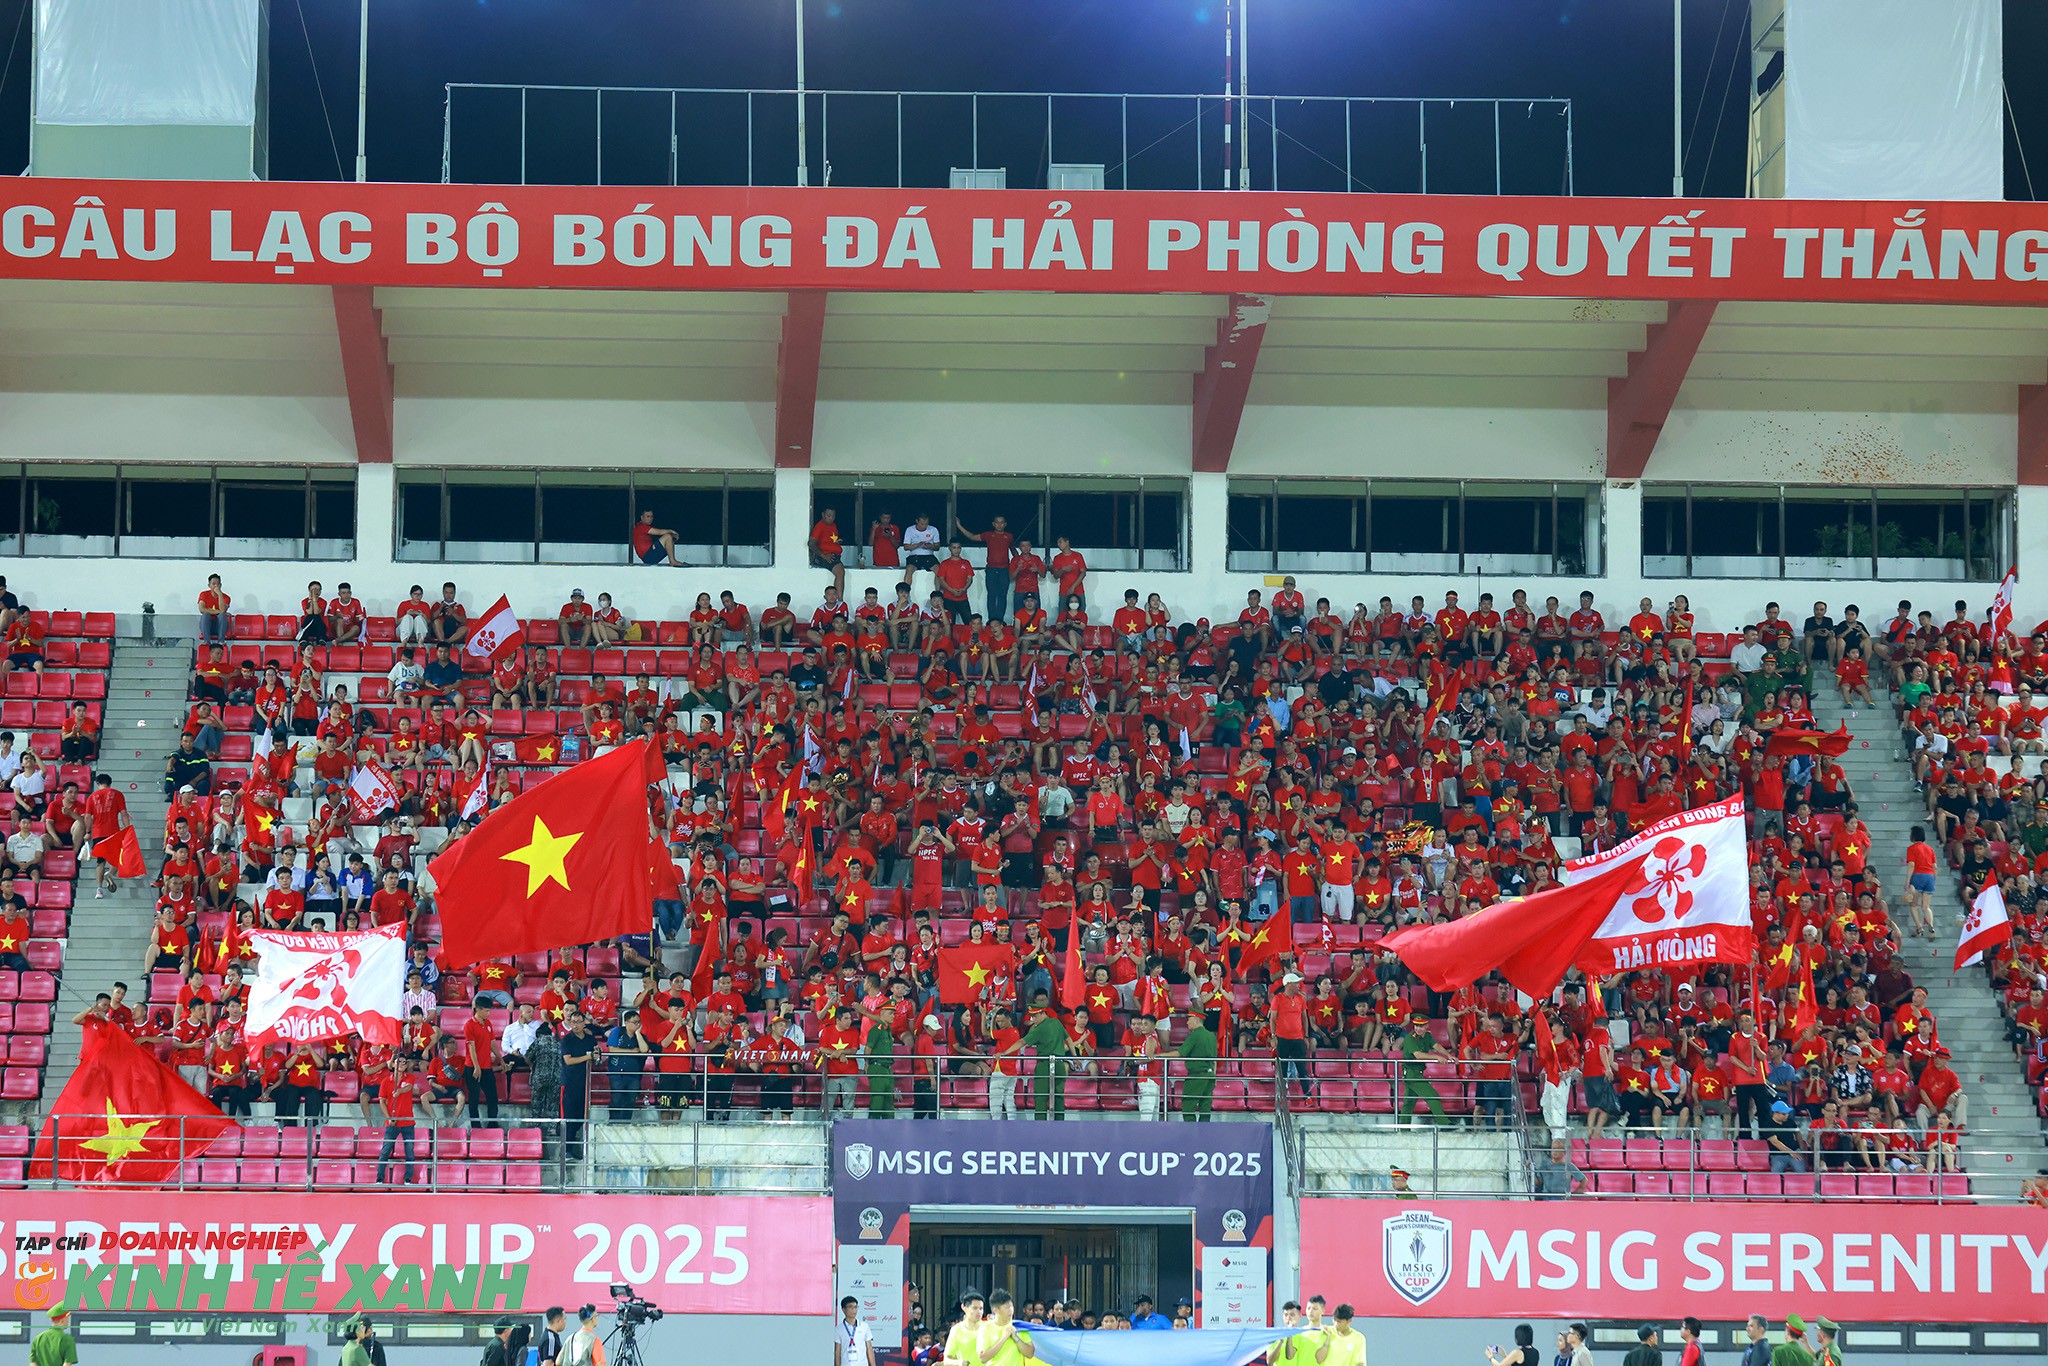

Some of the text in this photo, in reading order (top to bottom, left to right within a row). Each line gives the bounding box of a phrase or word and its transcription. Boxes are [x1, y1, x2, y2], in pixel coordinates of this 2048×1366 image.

[3, 196, 2048, 283] CÂU LẠC BỘ BÓNG ĐÁ HẢI PHÒNG QUYẾT THẮNG
[1613, 937, 1653, 969] HẢI
[780, 1050, 811, 1061] NAM
[877, 1150, 953, 1175] MSIG
[962, 1150, 1112, 1176] SERENITY
[1193, 1152, 1262, 1177] 2025
[1405, 1213, 1430, 1223] ASEAN
[573, 1224, 751, 1286] 2025
[1402, 1263, 1433, 1272] MSIG
[1467, 1230, 2048, 1294] MSIG SERENITY
[1405, 1277, 1430, 1287] CUP
